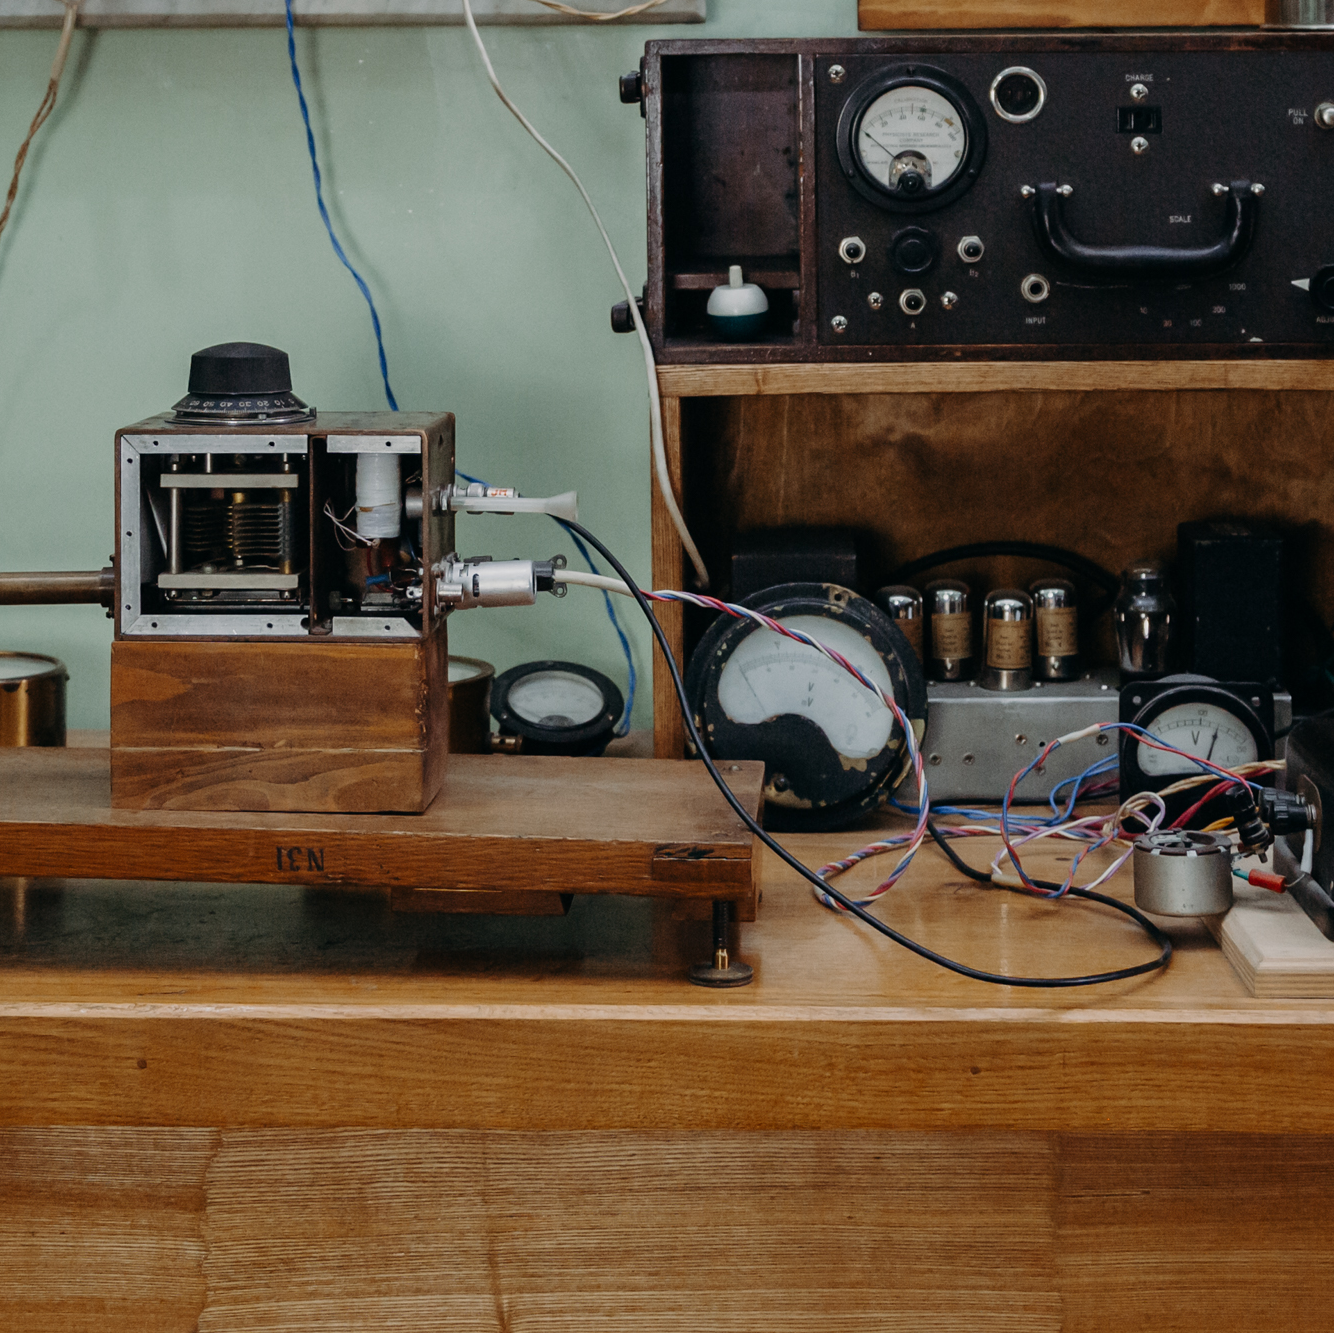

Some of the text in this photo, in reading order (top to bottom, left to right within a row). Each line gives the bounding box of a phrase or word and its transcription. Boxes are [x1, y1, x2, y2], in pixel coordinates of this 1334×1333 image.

[1124, 73, 1155, 82] CHARGE
[1287, 107, 1308, 117] PULL
[1292, 117, 1305, 126] ON
[1169, 215, 1193, 224] SCALE
[1025, 316, 1046, 325] INPUT
[1191, 730, 1200, 746] V
